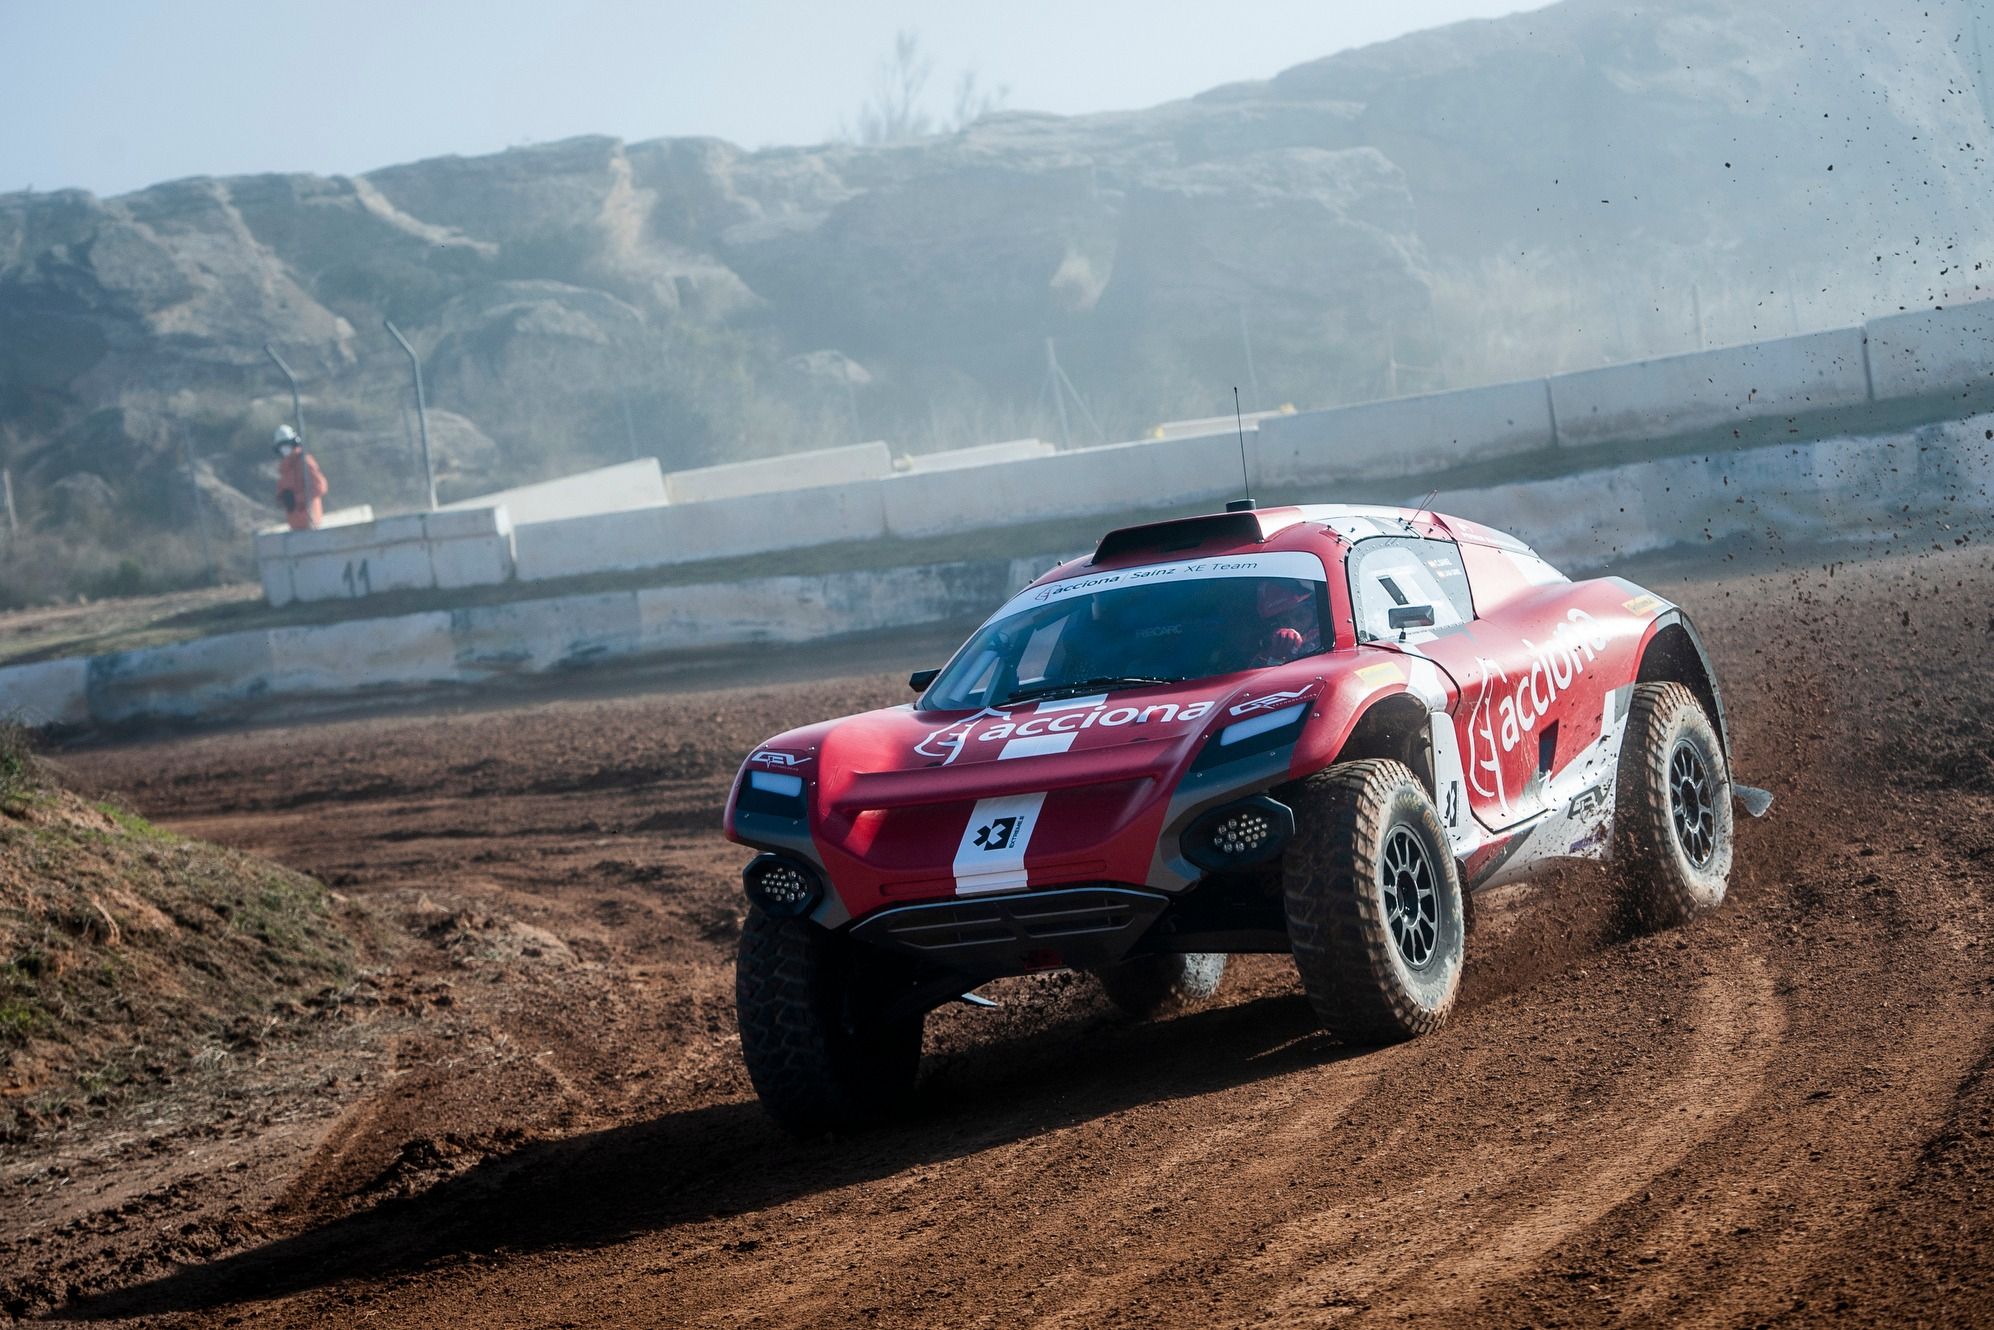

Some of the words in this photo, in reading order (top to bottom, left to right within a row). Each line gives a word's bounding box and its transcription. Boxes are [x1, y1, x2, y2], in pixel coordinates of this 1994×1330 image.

[1052, 575, 1119, 595] acciona
[1130, 567, 1176, 580] Sainz
[1183, 564, 1205, 573] XE
[1212, 561, 1258, 572] Team
[1499, 608, 1610, 752] acciona
[978, 700, 1216, 741] acciona
